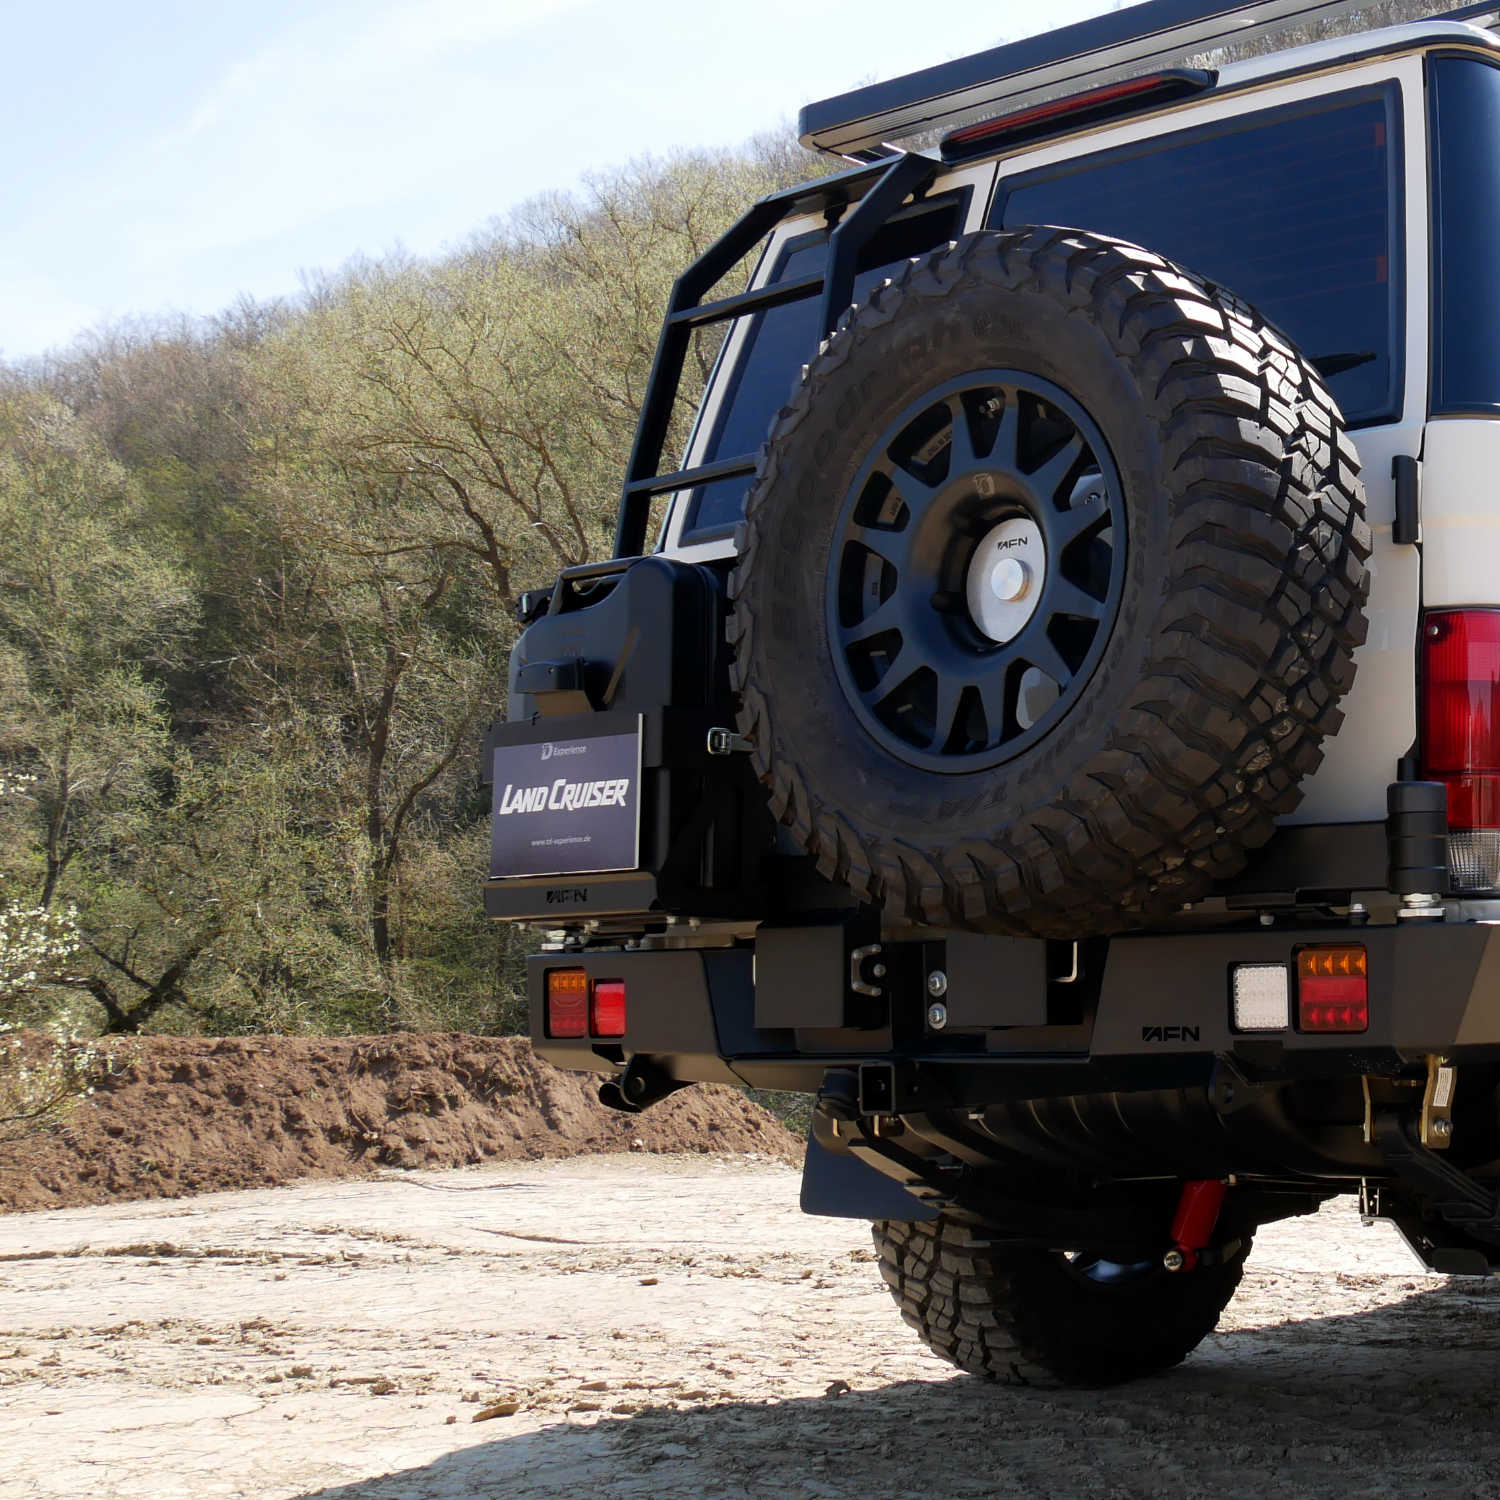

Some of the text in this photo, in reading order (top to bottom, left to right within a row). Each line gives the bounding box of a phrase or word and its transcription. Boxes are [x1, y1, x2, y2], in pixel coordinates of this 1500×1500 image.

[498, 778, 629, 815] LAND CRUISER
[1142, 1026, 1200, 1042] AFN
